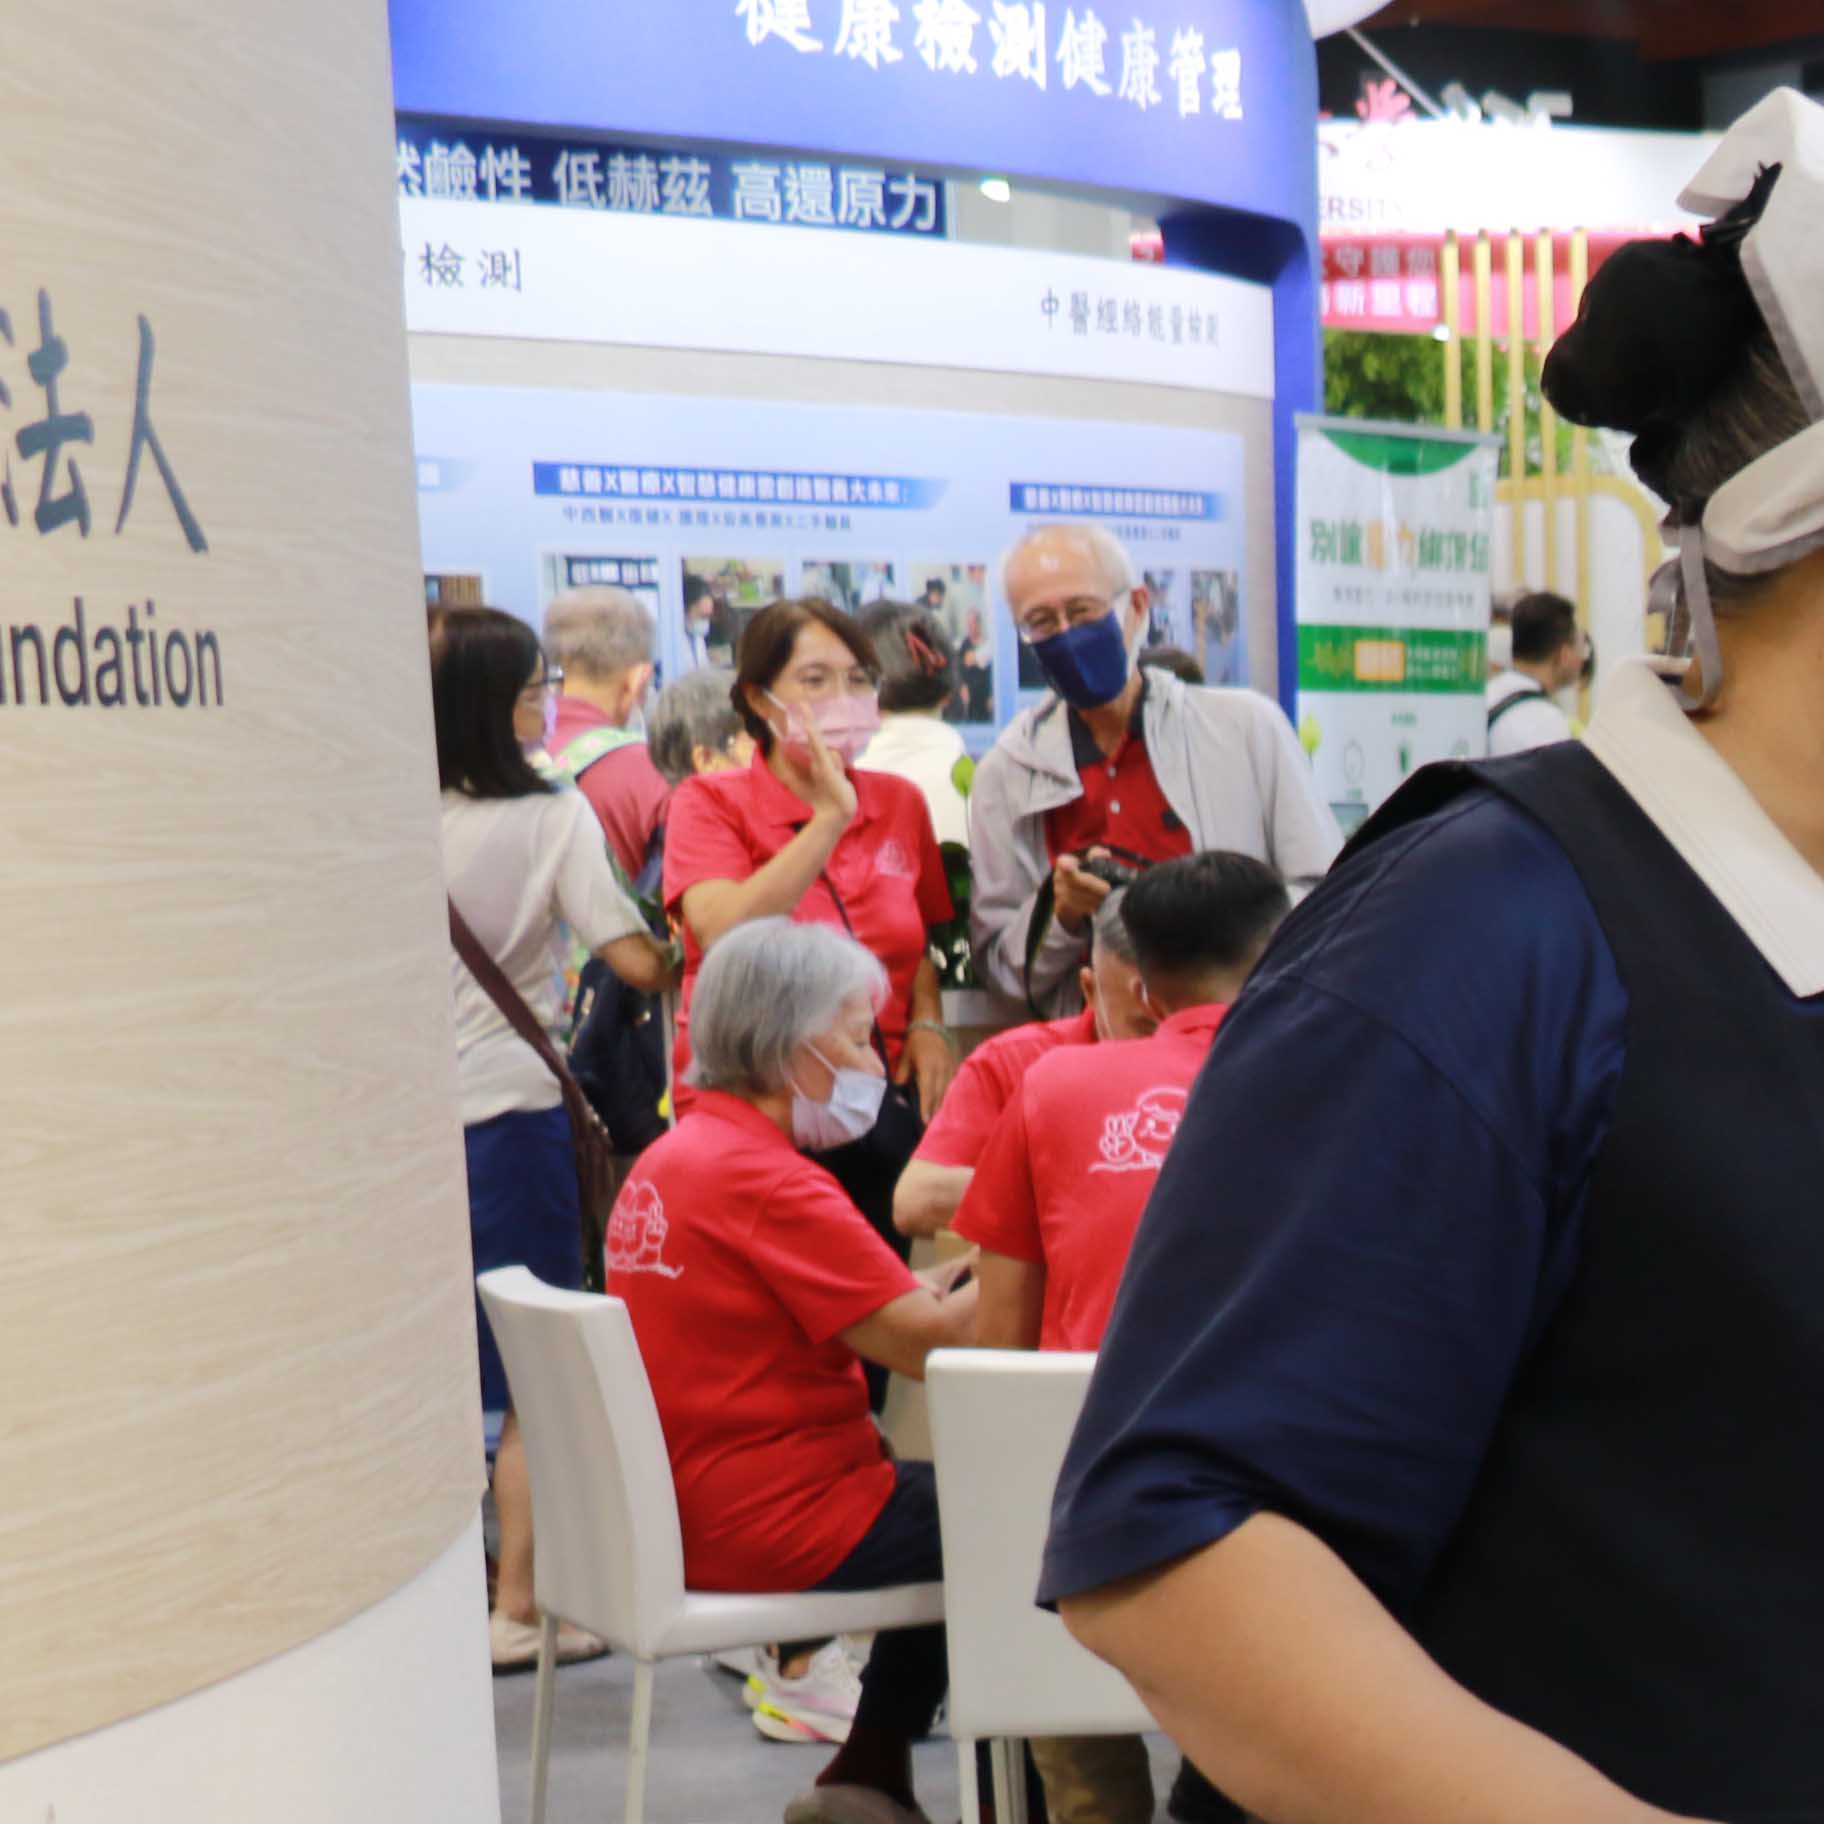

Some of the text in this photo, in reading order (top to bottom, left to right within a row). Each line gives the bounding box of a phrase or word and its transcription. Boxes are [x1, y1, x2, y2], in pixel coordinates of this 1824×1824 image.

[732, 161, 938, 231] 高還原力
[0, 597, 223, 707] ndation
